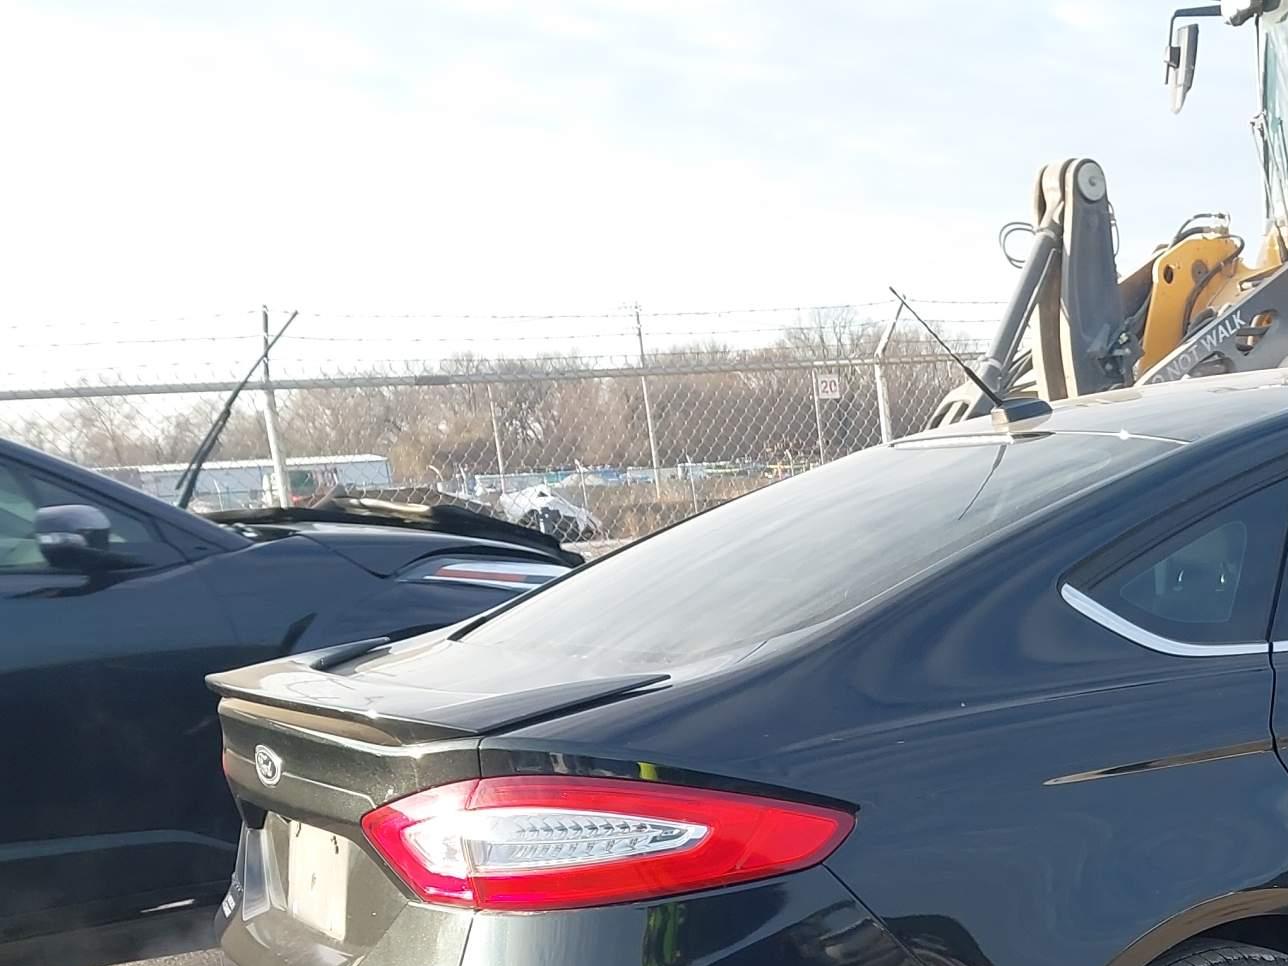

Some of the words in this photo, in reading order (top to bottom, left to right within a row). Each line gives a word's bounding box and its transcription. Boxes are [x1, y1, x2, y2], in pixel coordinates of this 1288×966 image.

[1166, 344, 1201, 380] NOT
[1200, 310, 1246, 351] WALK
[820, 379, 838, 394] 20
